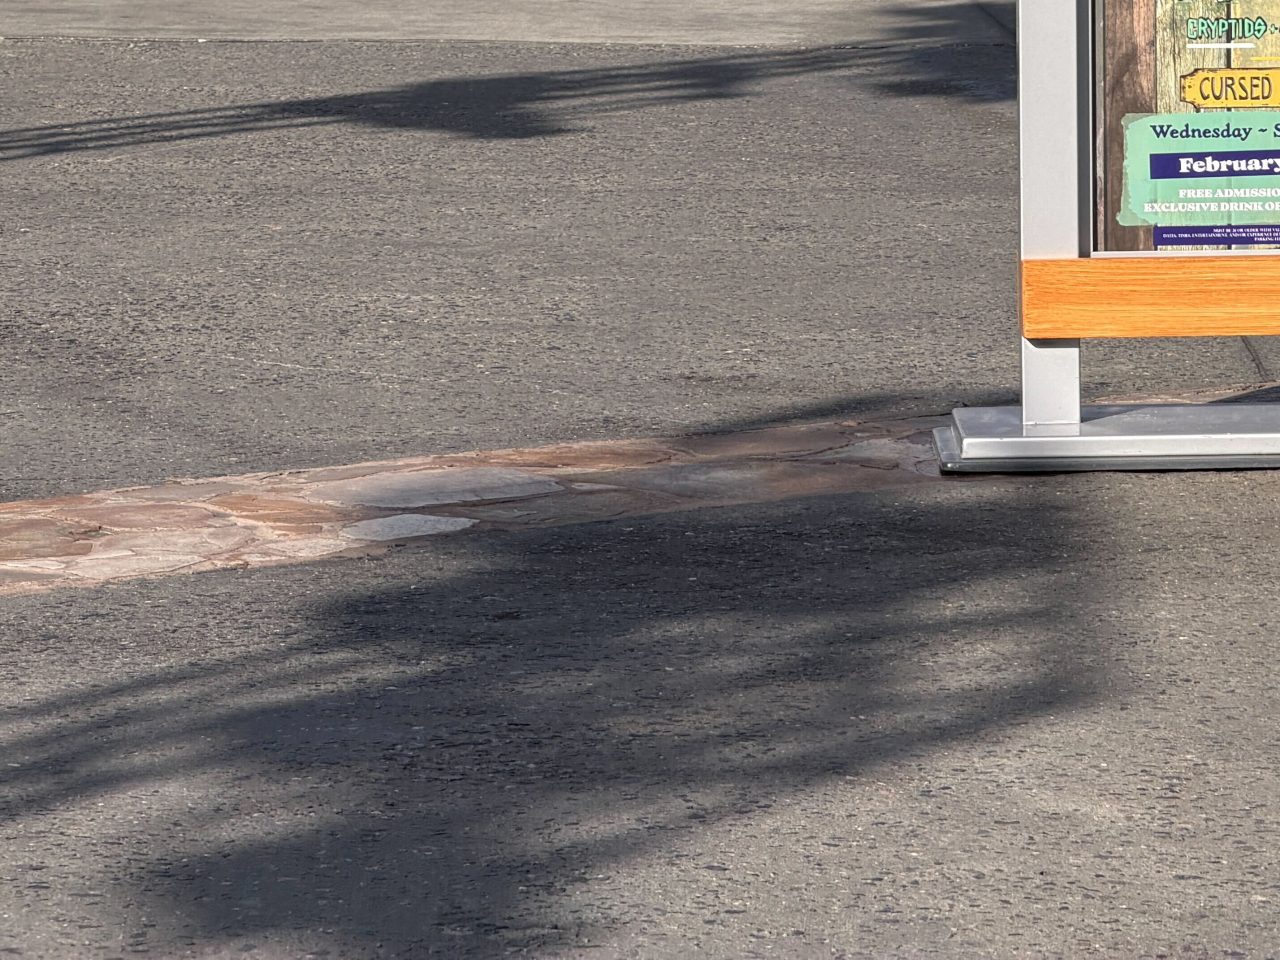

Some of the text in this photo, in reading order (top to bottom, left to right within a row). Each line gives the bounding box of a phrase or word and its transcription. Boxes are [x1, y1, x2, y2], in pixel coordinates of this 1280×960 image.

[1186, 16, 1268, 41] CRYPTIDS
[1199, 76, 1273, 102] CURSED
[1150, 123, 1253, 141] Wednesday
[1178, 189, 1213, 199] FREE
[1144, 201, 1219, 212] EXCLUSIVE
[1219, 201, 1264, 212] DRINK
